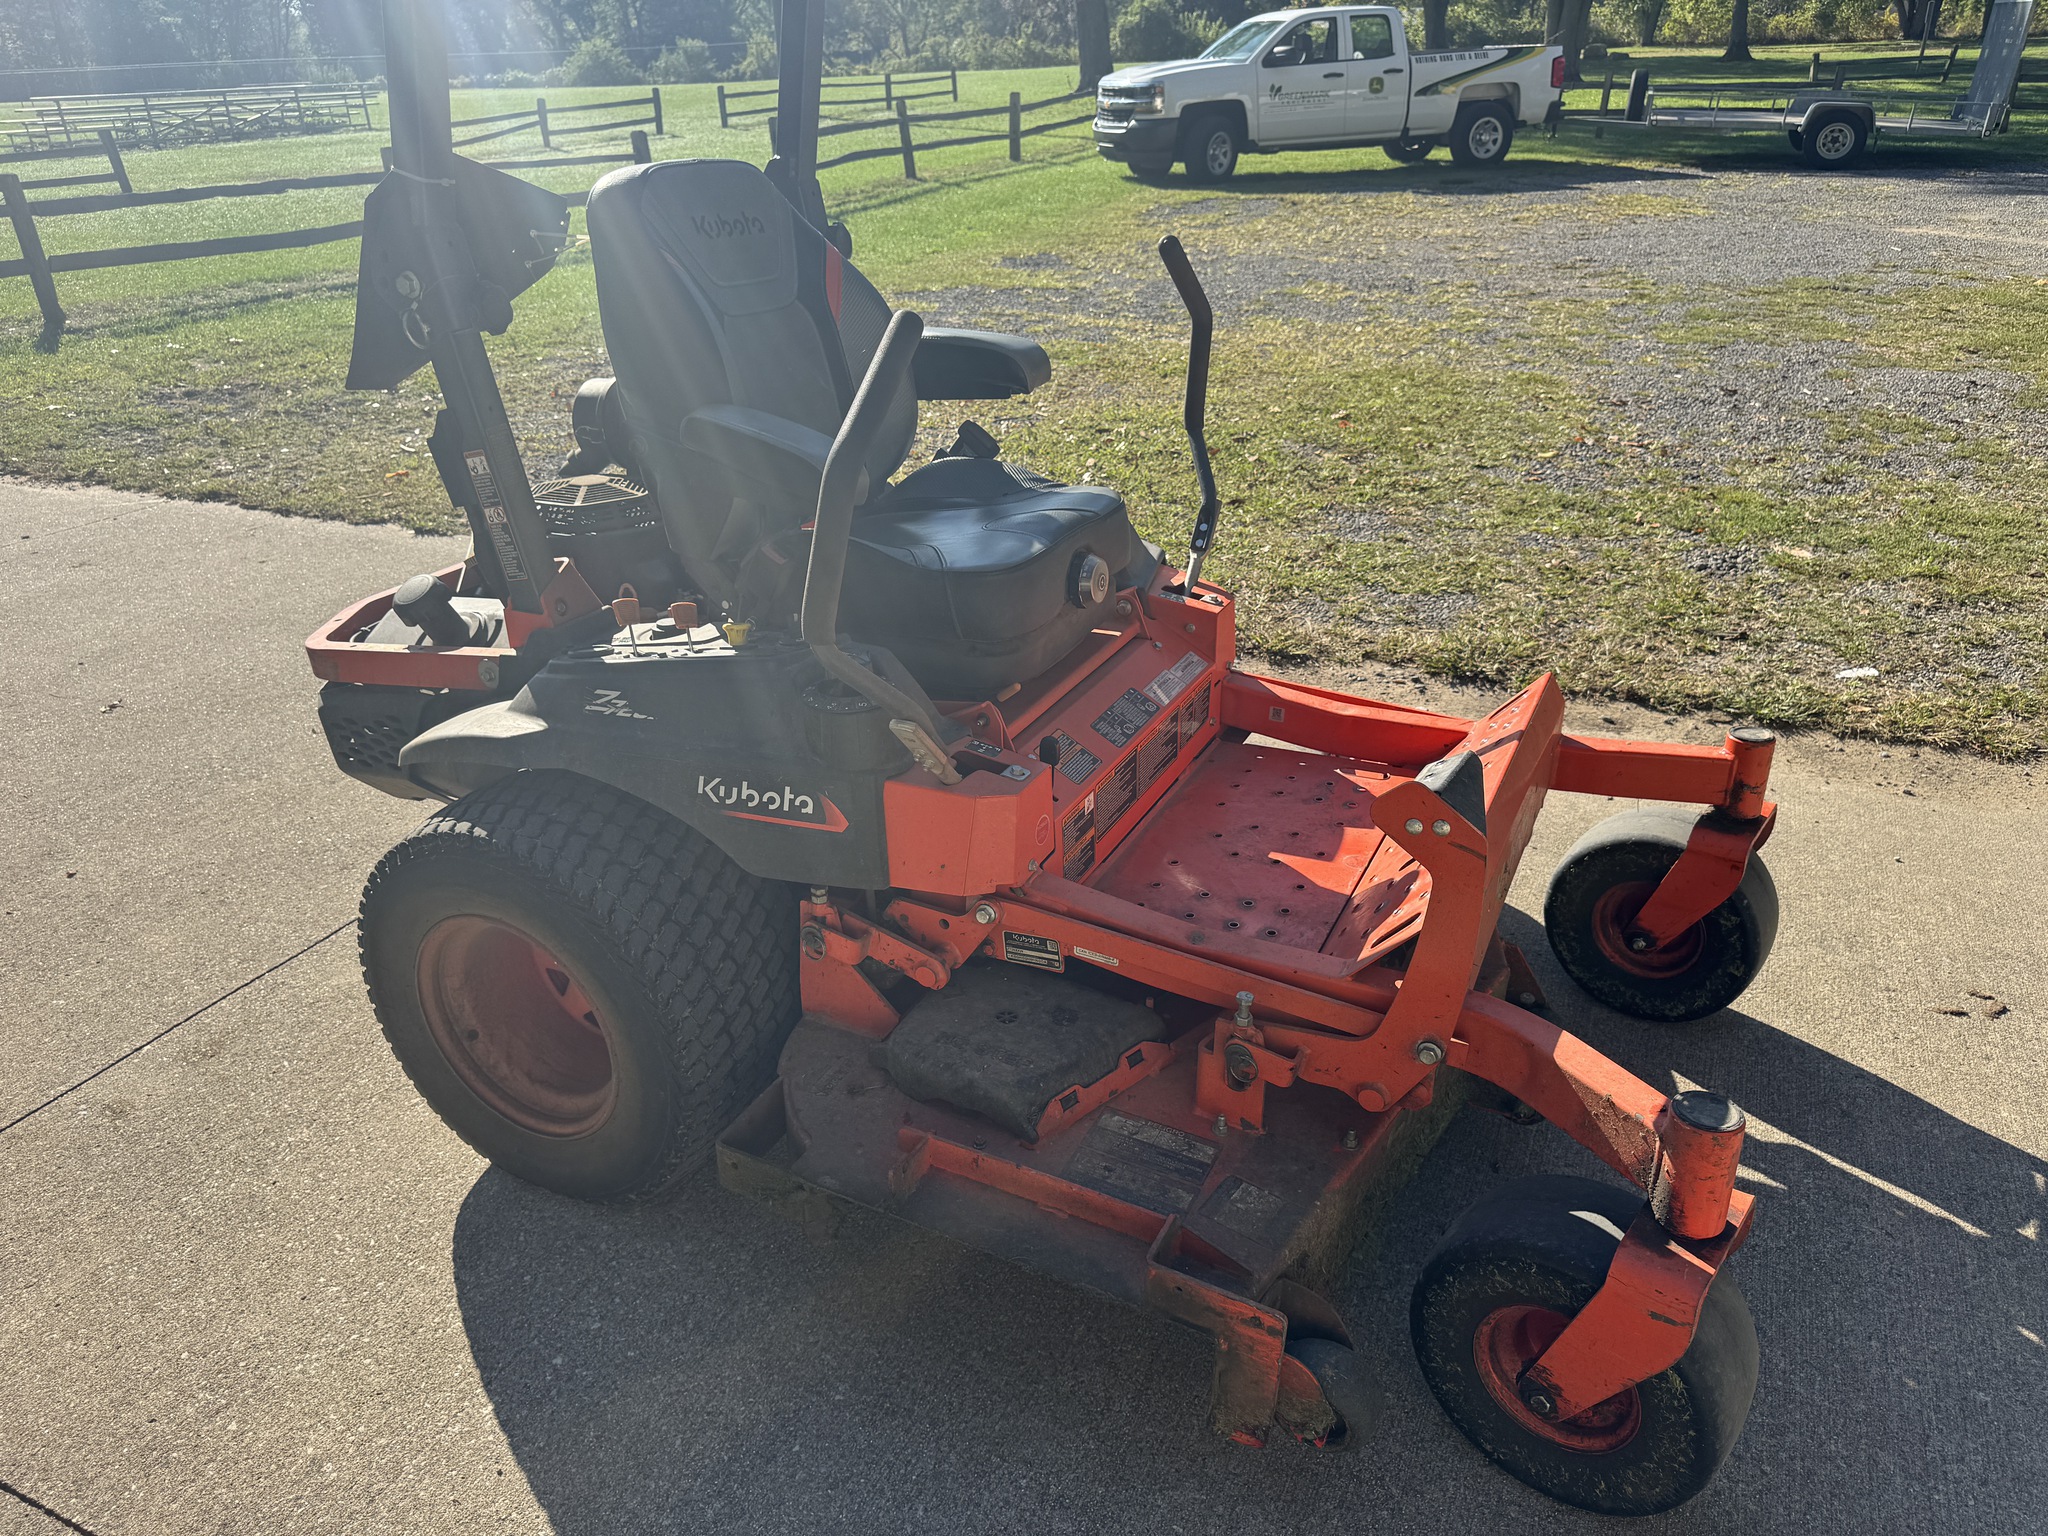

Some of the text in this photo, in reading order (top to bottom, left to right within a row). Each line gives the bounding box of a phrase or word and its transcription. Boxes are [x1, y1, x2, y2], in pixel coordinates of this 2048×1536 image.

[691, 211, 766, 239] Kubota
[697, 775, 814, 814] Kubota
[1012, 933, 1040, 945] Kubota
[1147, 1121, 1185, 1137] PELIGRO
